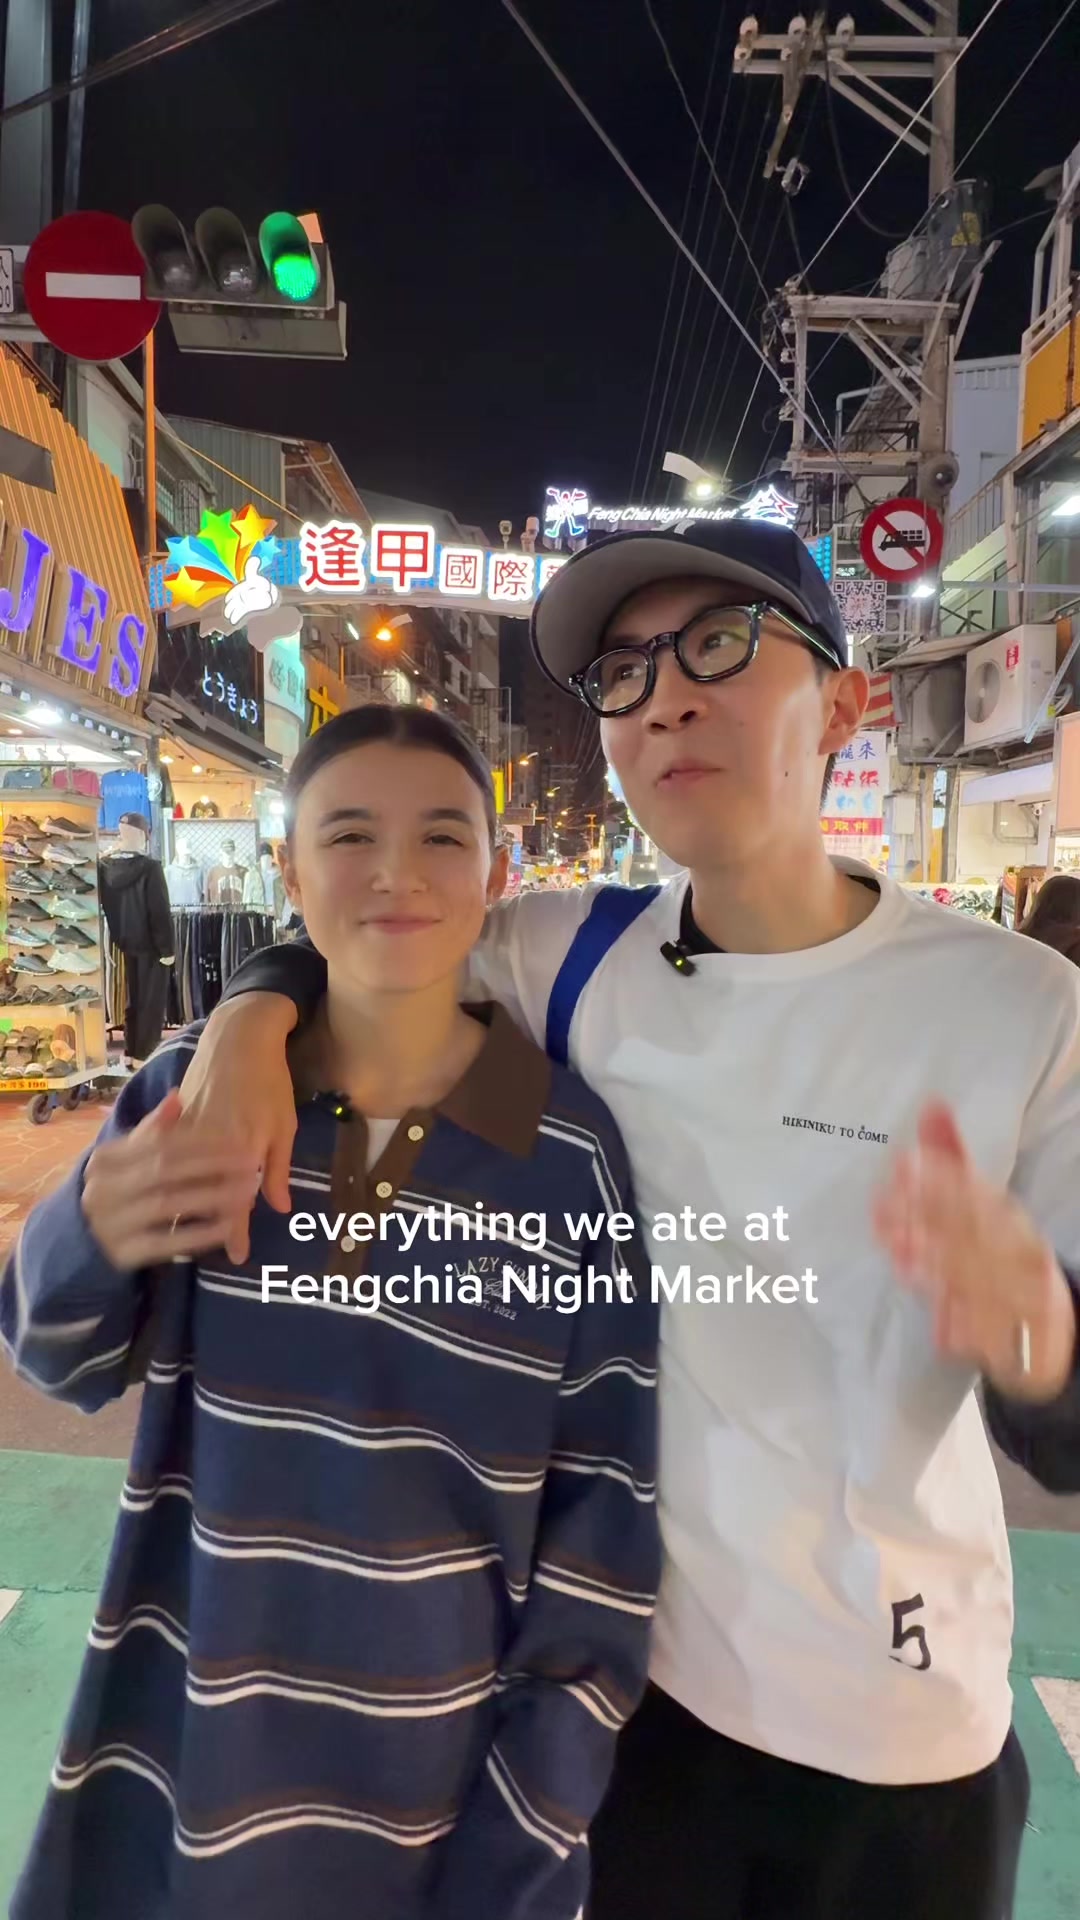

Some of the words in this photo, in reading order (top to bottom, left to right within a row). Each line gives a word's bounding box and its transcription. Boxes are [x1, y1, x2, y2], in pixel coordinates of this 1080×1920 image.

[587, 506, 621, 523] Feng
[650, 507, 688, 524] Night
[686, 506, 738, 521] Market
[303, 525, 560, 598] 逢甲國際
[202, 665, 258, 725] とうきょう
[782, 1115, 836, 1135] HIKINIKU
[839, 1126, 855, 1138] TO
[857, 1126, 889, 1144] COME
[453, 1256, 500, 1278] LAZY
[493, 1305, 518, 1321] 2022
[888, 1592, 931, 1671] 5
